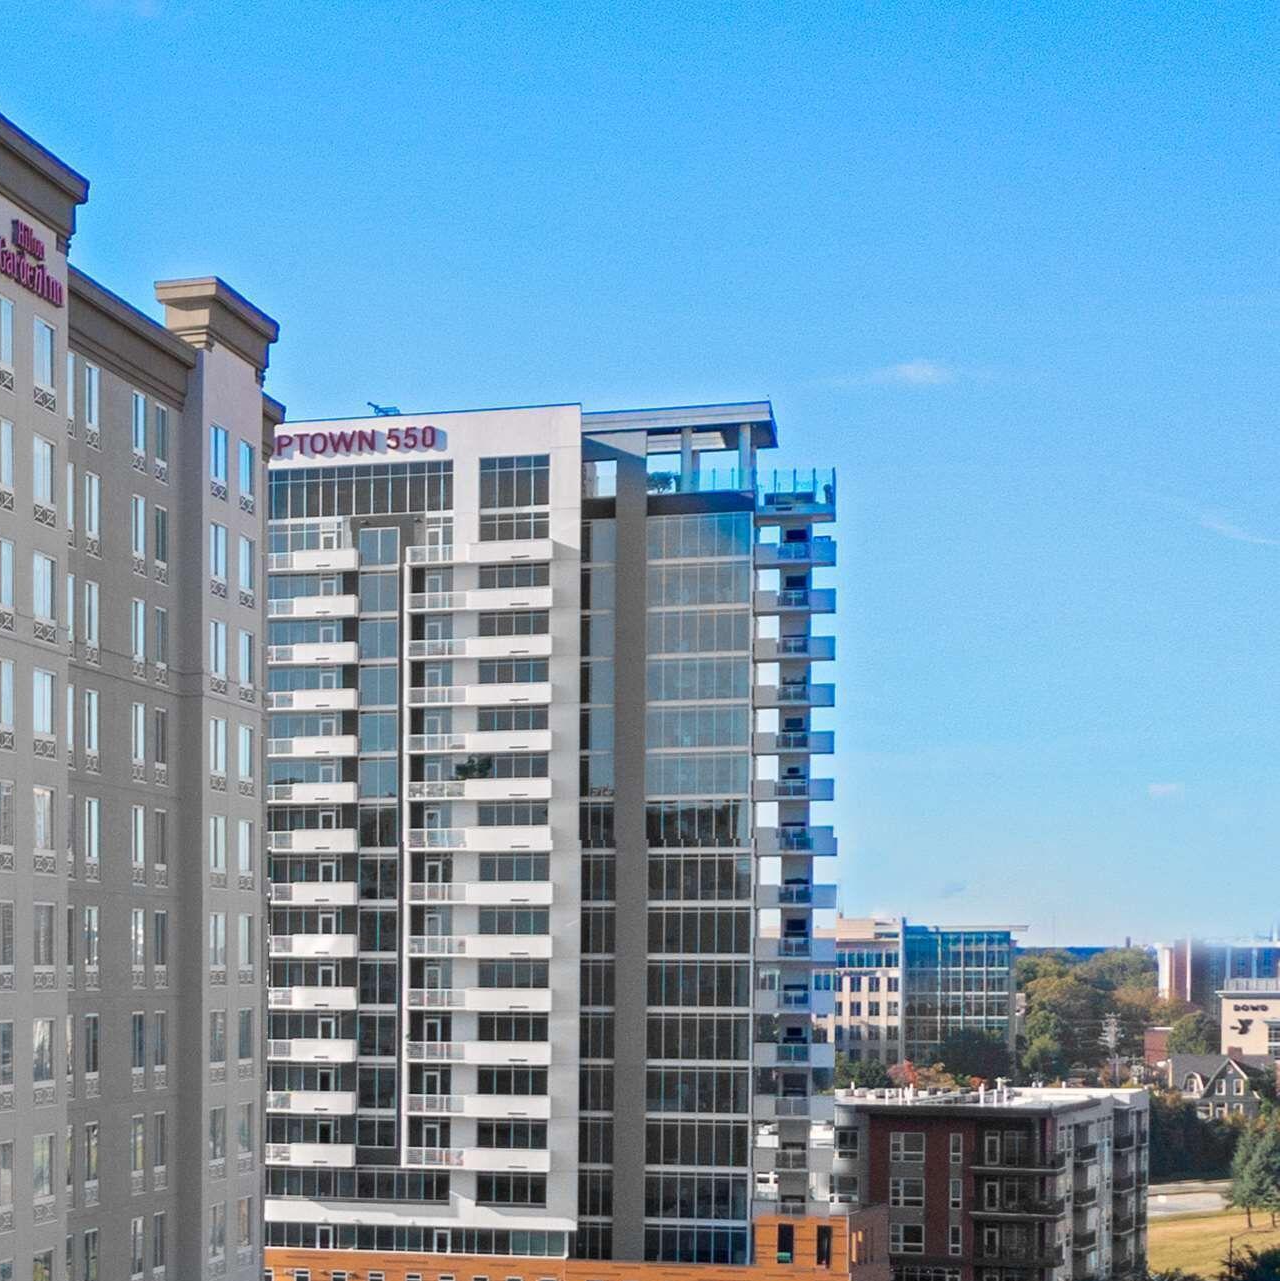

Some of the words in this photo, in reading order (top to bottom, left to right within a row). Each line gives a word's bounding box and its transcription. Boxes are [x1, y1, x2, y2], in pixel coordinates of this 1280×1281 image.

[12, 219, 45, 261] Hilton
[272, 429, 377, 457] PTOWN
[386, 426, 437, 450] 550
